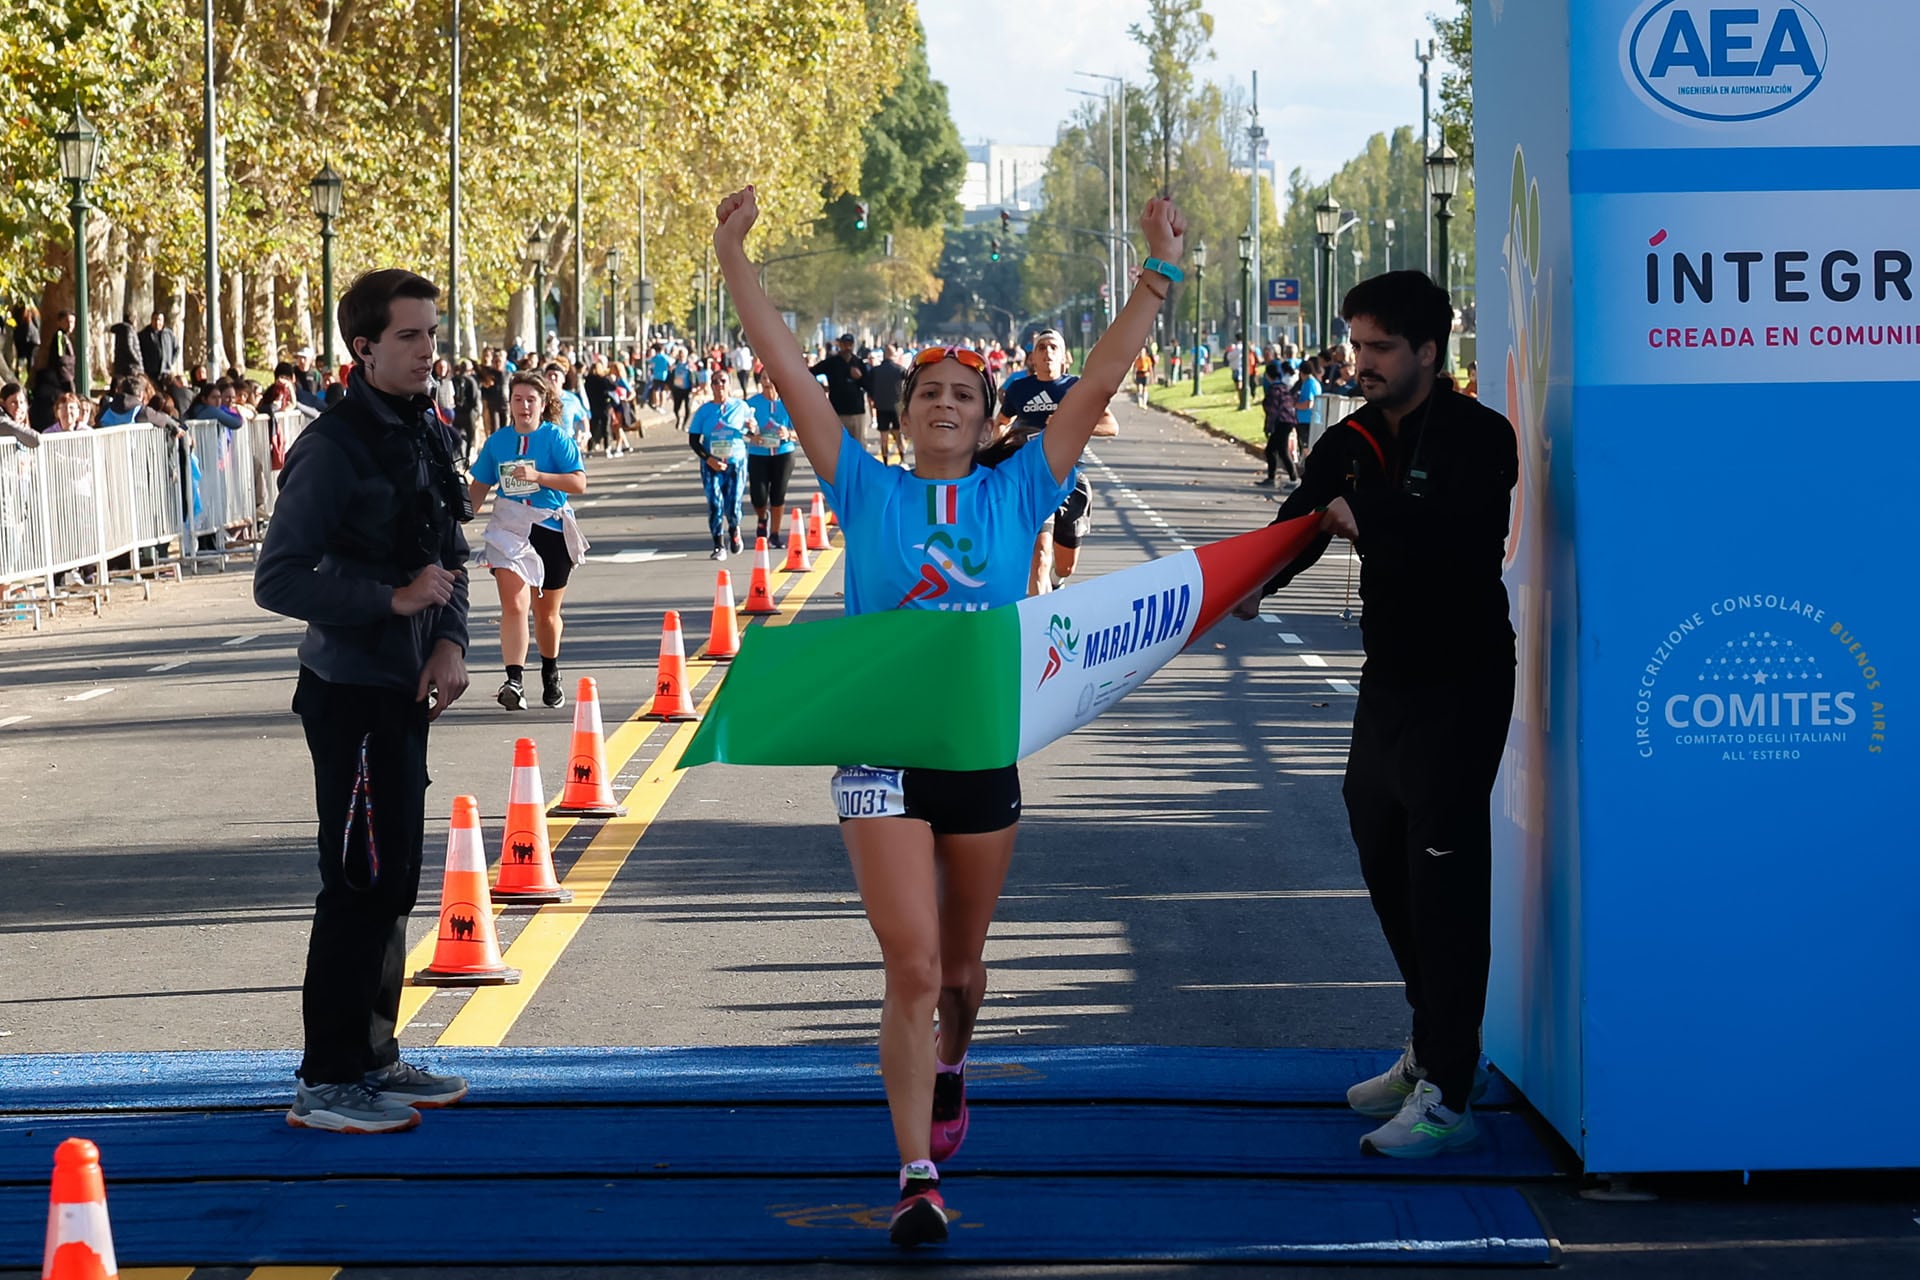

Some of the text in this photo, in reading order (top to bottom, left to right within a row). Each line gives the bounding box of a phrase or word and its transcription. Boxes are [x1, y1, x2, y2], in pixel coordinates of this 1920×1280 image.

[1649, 9, 1821, 77] AEA
[1678, 84, 1792, 95] INGENIERÍA EN AUTOMATIZACIÓN
[1275, 282, 1287, 298] E
[1649, 327, 1755, 348] CREADA
[1766, 326, 1799, 346] EN
[1023, 402, 1058, 413] adidas
[1083, 584, 1191, 669] MARATANA
[1635, 594, 1886, 758] CIRCOSCRIZIONE CONSOLARE BUENOS AIRES
[1664, 691, 1857, 729] COMITES
[1675, 732, 1847, 745] COMITATO DEGLI ITALIANI
